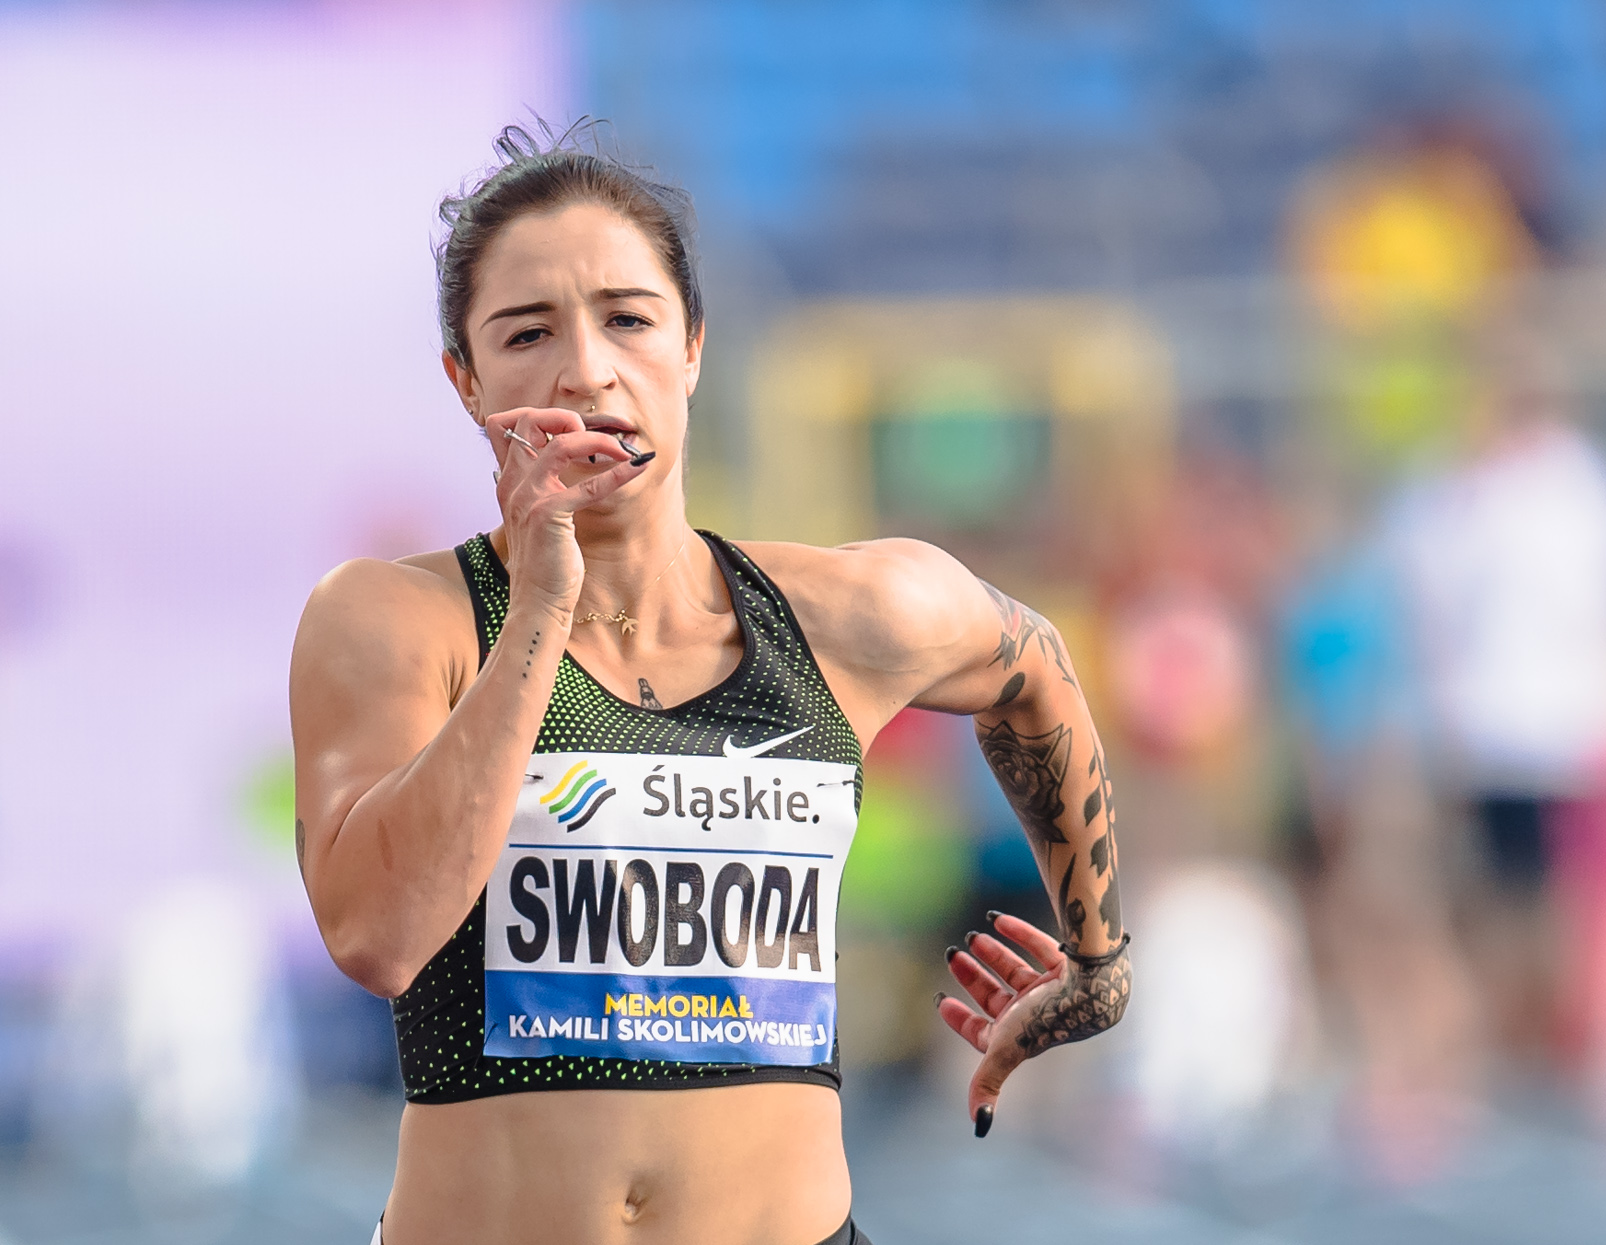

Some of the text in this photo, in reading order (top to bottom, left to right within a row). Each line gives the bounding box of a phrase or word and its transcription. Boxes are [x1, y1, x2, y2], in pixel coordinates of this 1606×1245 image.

[642, 764, 821, 831] Śląskie.
[505, 855, 822, 972] SWOBODA
[508, 1014, 827, 1047] KAMILI SKOLIMOWSKIEJ
[604, 993, 754, 1019] MEMORIAŁ
